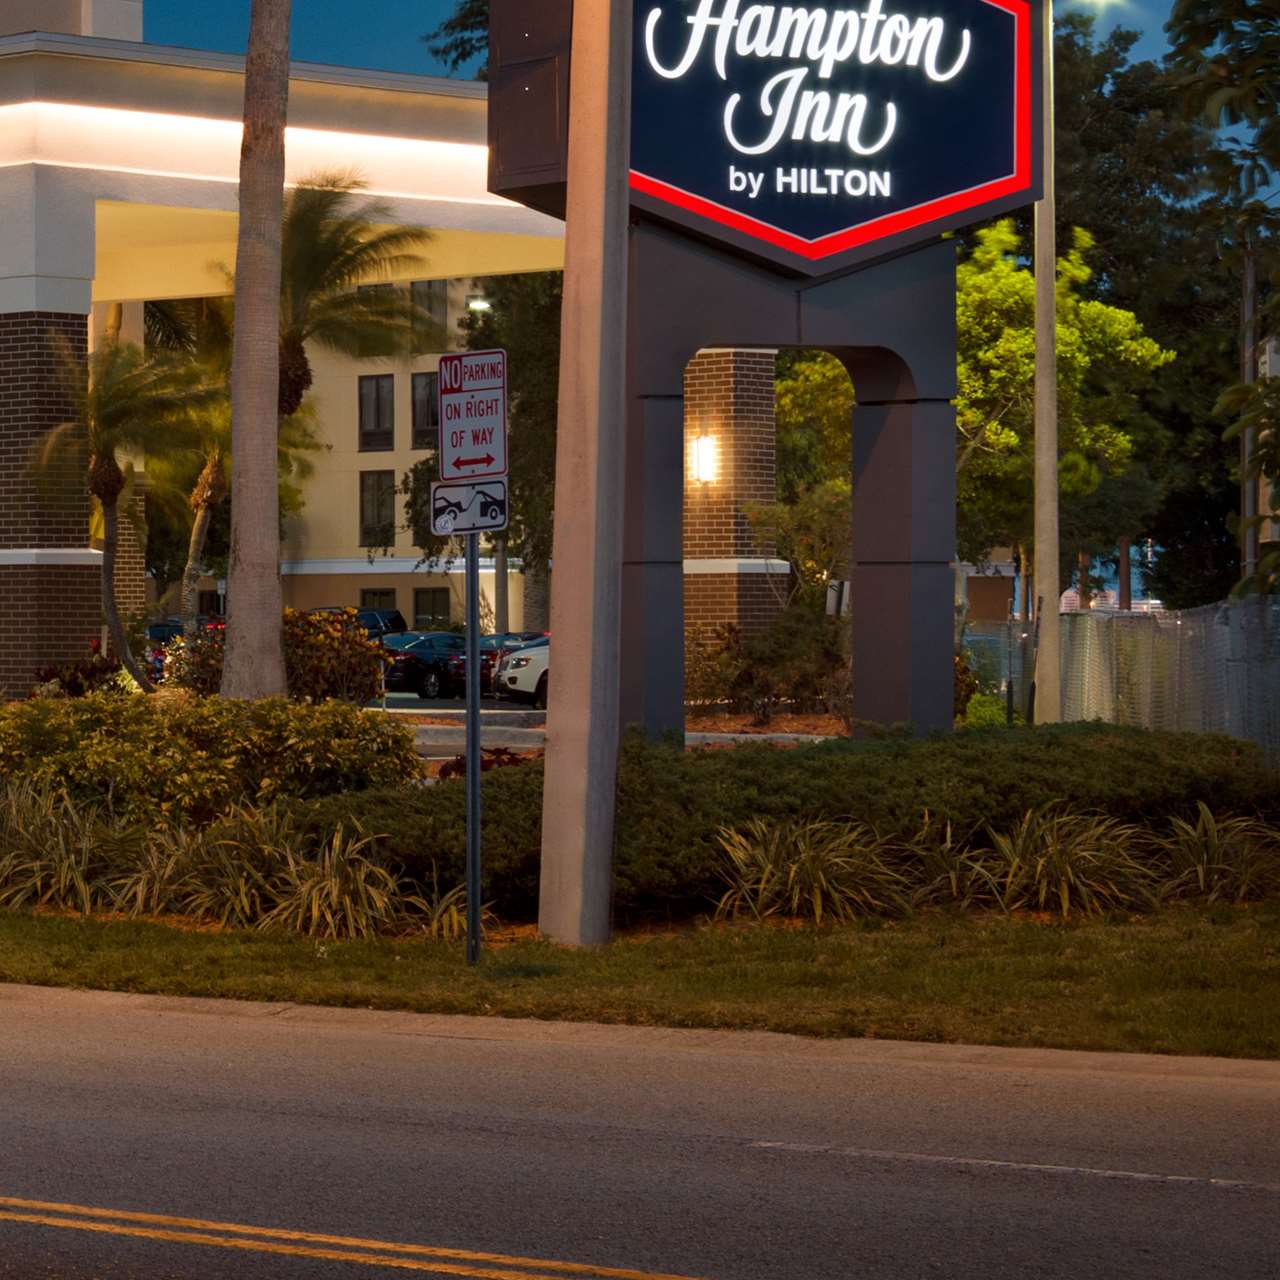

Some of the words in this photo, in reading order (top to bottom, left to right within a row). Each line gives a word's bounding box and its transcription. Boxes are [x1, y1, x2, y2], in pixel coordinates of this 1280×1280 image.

[723, 67, 897, 156] Inn
[728, 166, 764, 198] by
[775, 167, 891, 197] HILTON
[441, 360, 462, 390] NO
[463, 362, 502, 381] PARKING
[446, 403, 461, 420] ON
[465, 398, 500, 418] RIGHT
[450, 430, 466, 448] OF
[471, 427, 495, 446] WAY
